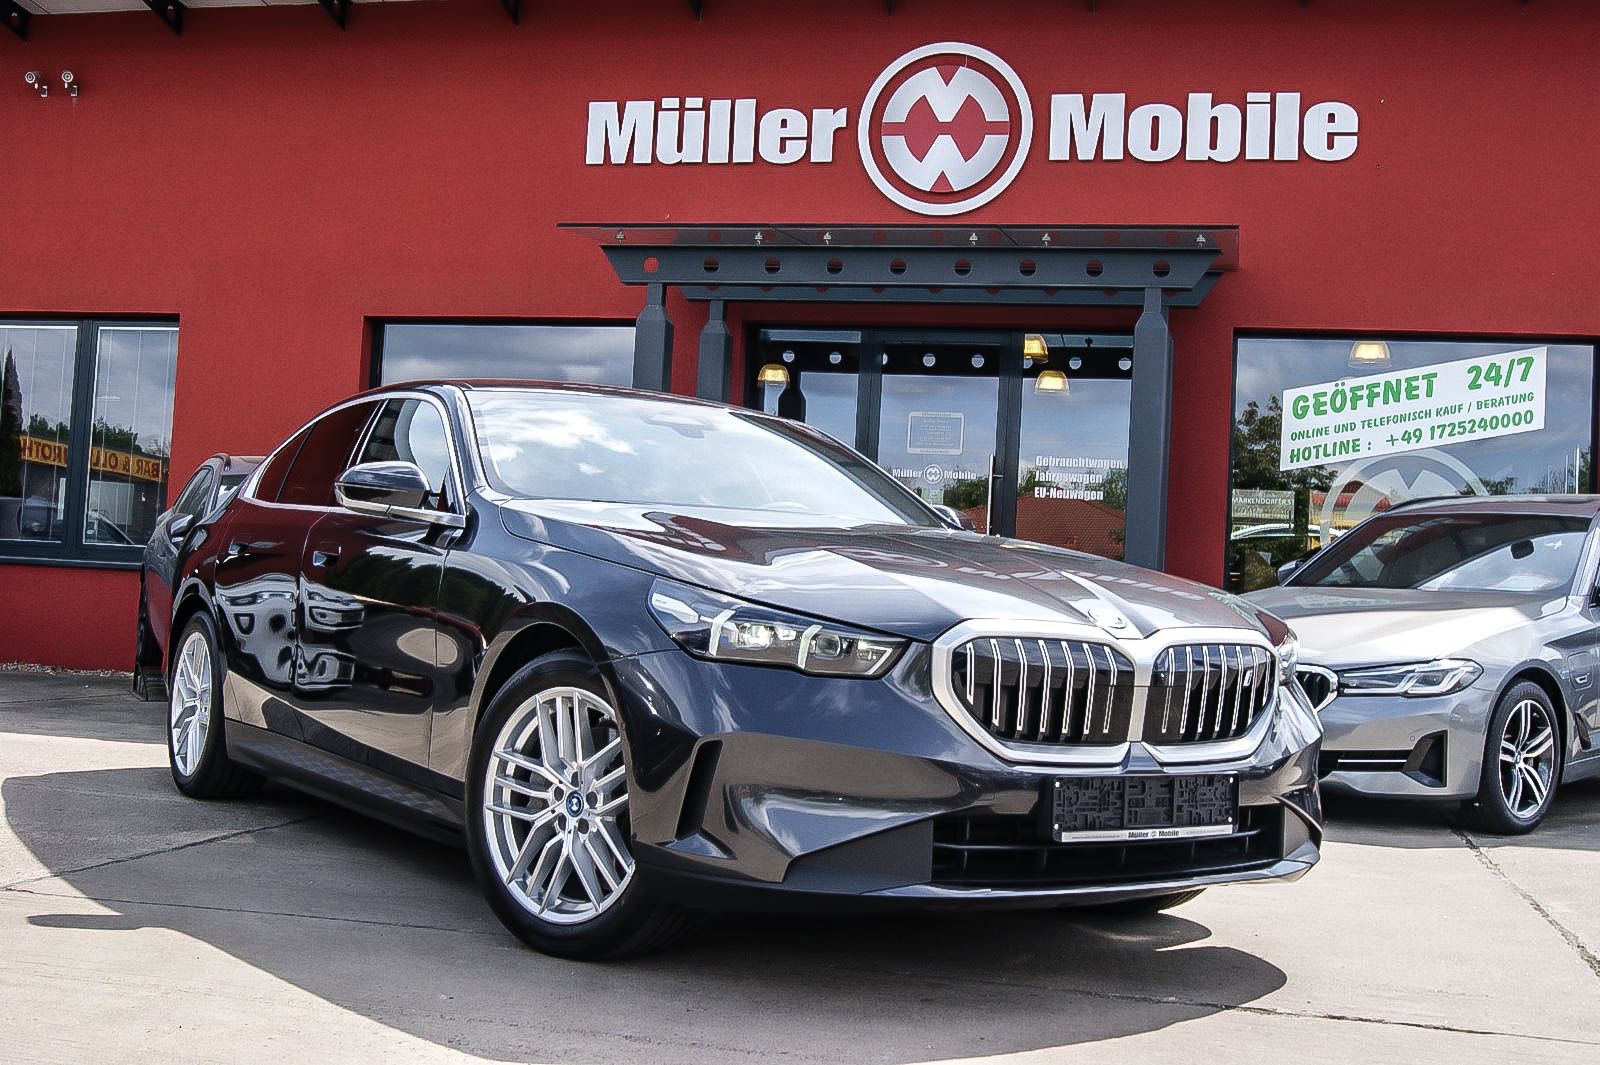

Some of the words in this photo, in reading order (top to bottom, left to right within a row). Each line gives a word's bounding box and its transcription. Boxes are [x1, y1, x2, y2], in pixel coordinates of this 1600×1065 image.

[585, 96, 848, 165] Müller
[1048, 91, 1360, 163] Mobile
[1292, 372, 1438, 420] GEÖFFNET
[1467, 356, 1535, 390] 24/7
[1290, 426, 1330, 441] ONLINE
[1333, 422, 1357, 434] UND
[1360, 409, 1432, 430] TELEFONISCH
[1435, 403, 1464, 417] KAUF
[1476, 391, 1535, 410] BERATUNG
[1289, 438, 1361, 463] HOTLINE
[1385, 428, 1423, 446] +49
[1429, 409, 1534, 440] 1725240000
[1036, 455, 1123, 469] Gebrauchtwagen
[892, 467, 923, 478] Müller
[944, 470, 977, 480] Mobile
[1034, 470, 1103, 484] Jahreswagen
[1034, 486, 1104, 501] EU-Neuwagen
[1128, 831, 1149, 839] Müller
[1158, 829, 1180, 837] Mobile
